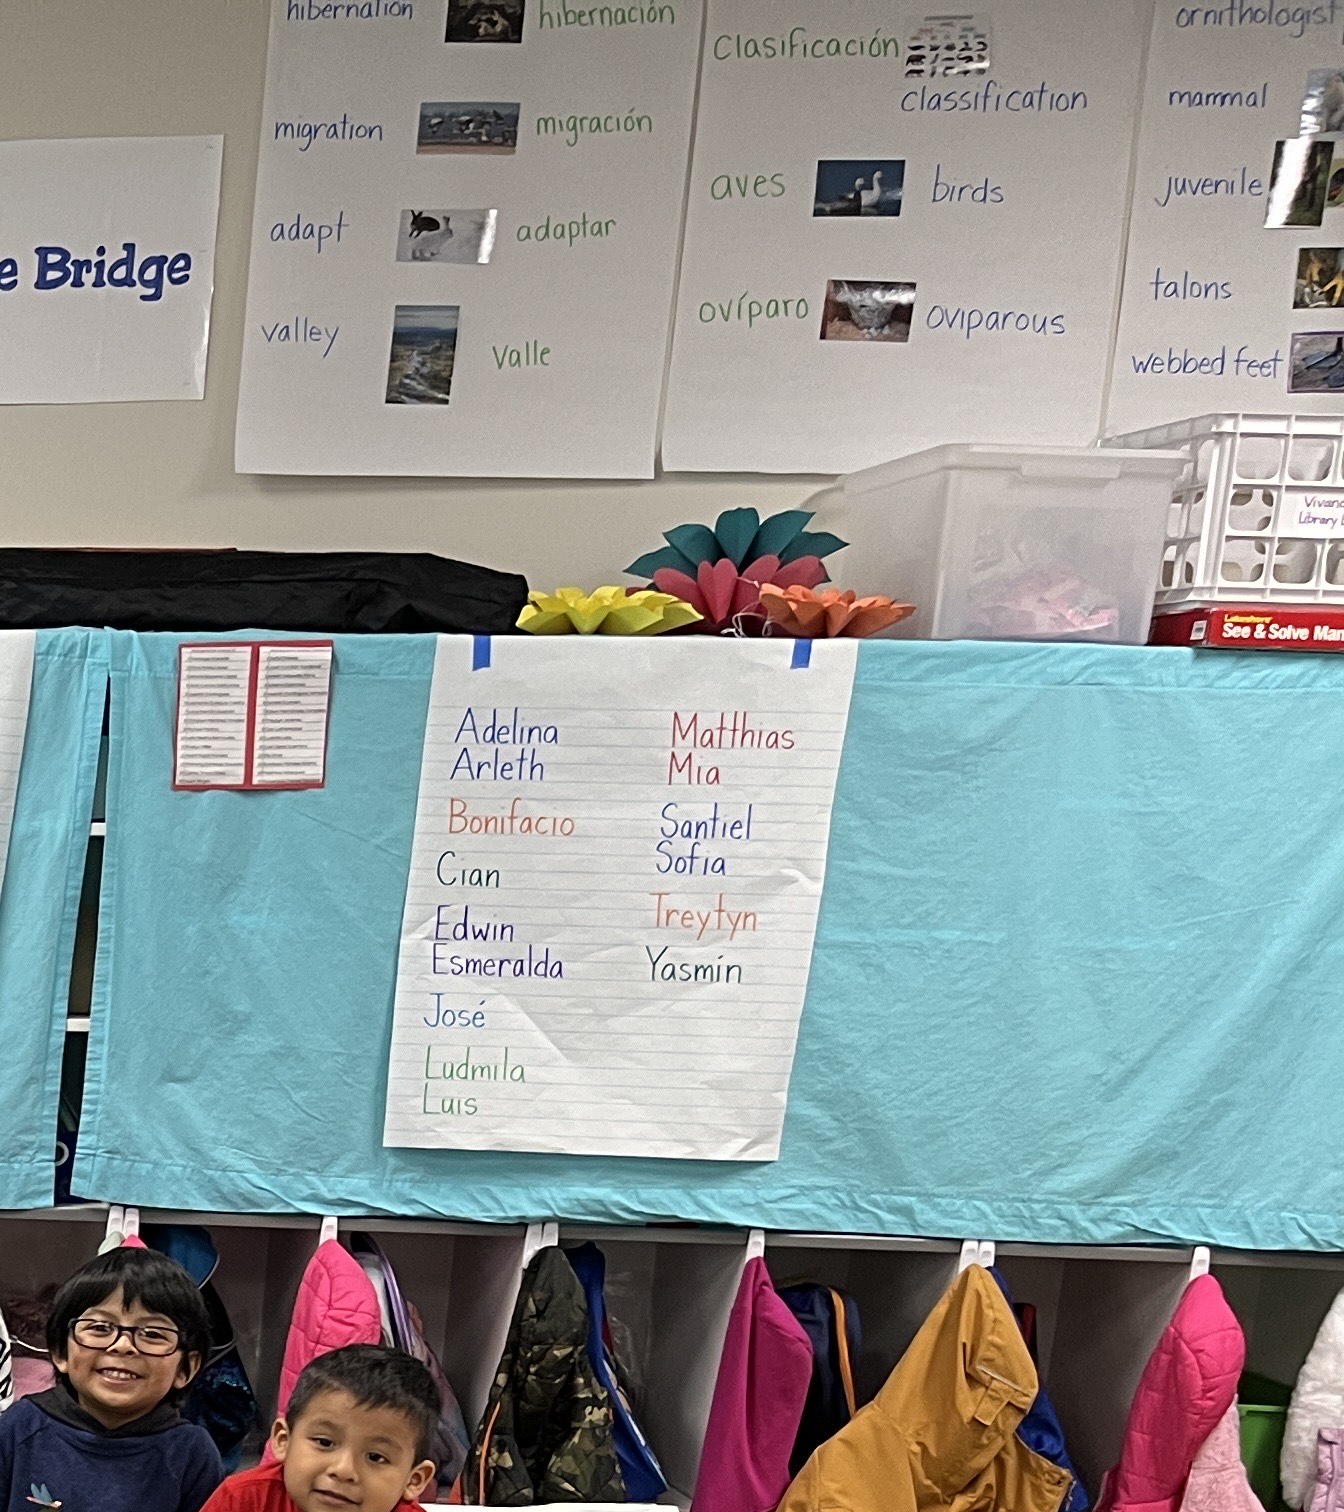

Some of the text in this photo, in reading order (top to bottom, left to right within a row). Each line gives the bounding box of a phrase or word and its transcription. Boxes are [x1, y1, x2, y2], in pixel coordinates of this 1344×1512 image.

[539, 2, 675, 30] hibernación
[1176, 0, 1341, 38] ornithologist
[901, 80, 1088, 113] classification
[1168, 83, 1268, 109] mammal
[274, 114, 383, 151] migration
[536, 109, 652, 146] migración
[711, 172, 785, 200] aves
[932, 164, 1005, 203] birds
[1154, 167, 1264, 207] juvenile
[270, 211, 350, 253] adapt
[516, 213, 616, 247] adaptar
[34, 245, 194, 304] Bridge
[1150, 267, 1233, 300] talons
[699, 291, 809, 328] ovíparo
[926, 305, 1066, 339] oviparous
[261, 316, 340, 359] valley
[1132, 345, 1284, 378] webbed feet
[1222, 623, 1251, 638] See
[1254, 624, 1266, 639] &
[1268, 624, 1309, 641] Solve
[454, 708, 559, 745] Adelina
[671, 711, 796, 750] Matthias
[450, 747, 544, 781] Arleth
[668, 752, 721, 785] Mia
[448, 798, 575, 836] Bonifacio
[660, 802, 753, 840] Santiel
[437, 851, 500, 888] Cian
[656, 841, 727, 876] Sofia
[434, 905, 515, 942] Edwin
[650, 893, 758, 941] Treytyn
[432, 943, 564, 979] Esmeralda
[424, 993, 486, 1028] José
[425, 1045, 526, 1083] Ludmila
[423, 1083, 479, 1116] Luis
